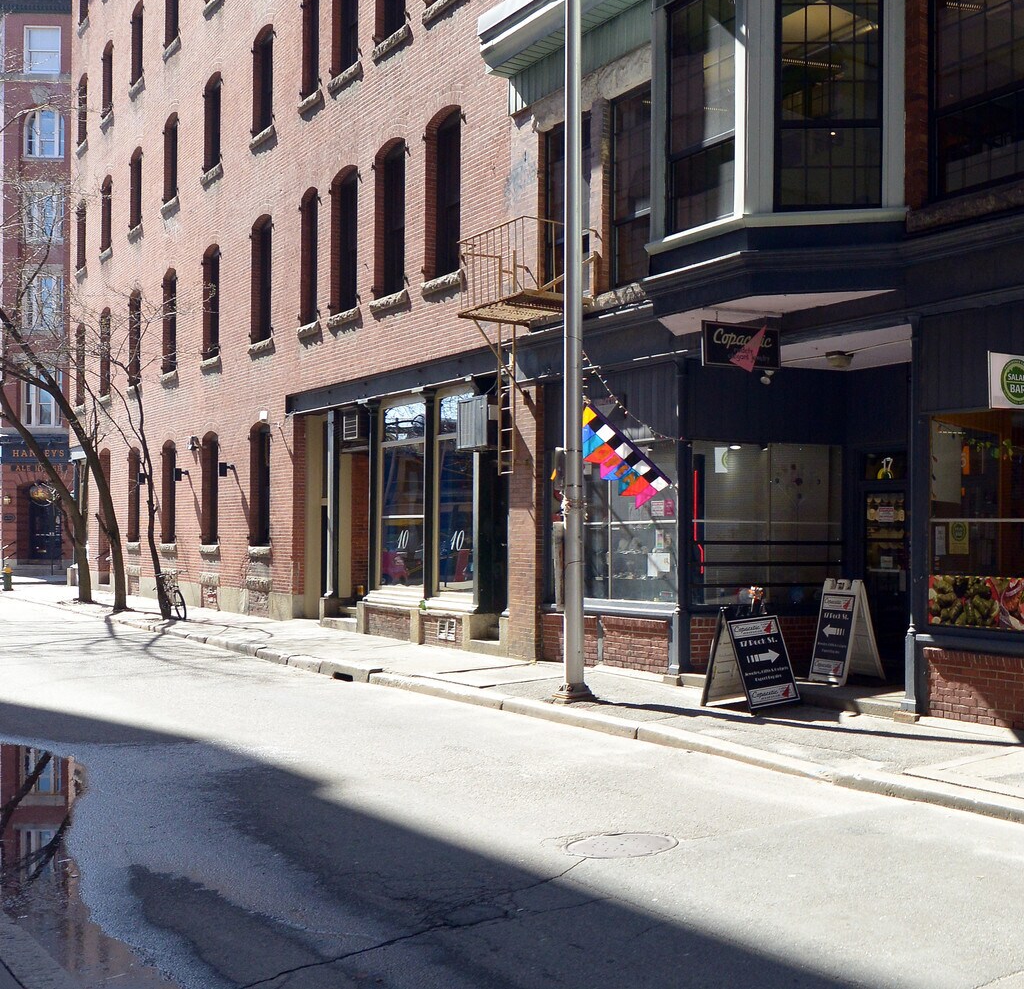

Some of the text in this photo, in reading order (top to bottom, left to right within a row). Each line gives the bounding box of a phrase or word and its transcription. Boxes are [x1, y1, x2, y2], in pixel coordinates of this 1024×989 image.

[713, 328, 772, 349] Copacic
[882, 457, 893, 471] 17
[397, 529, 409, 549] 10
[450, 529, 465, 551] 10
[748, 638, 765, 647] Peck
[767, 636, 778, 644] St.
